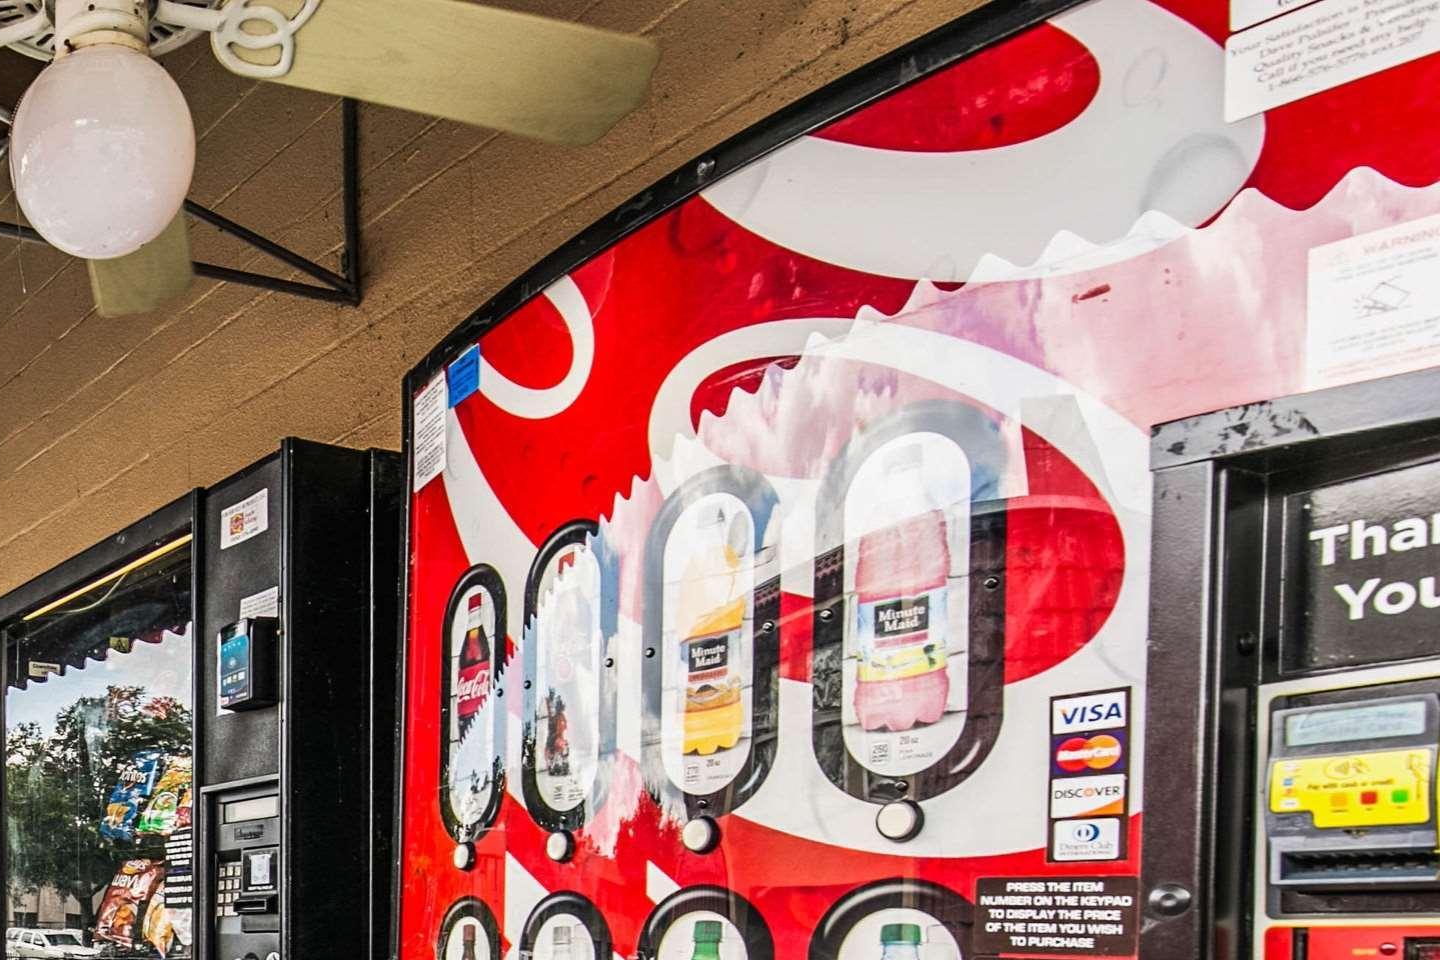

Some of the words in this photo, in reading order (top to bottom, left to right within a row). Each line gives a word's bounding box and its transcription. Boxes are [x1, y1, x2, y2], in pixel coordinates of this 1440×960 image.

[1308, 511, 1440, 566] Tha
[878, 604, 926, 622] Minute
[884, 618, 921, 633] Maid
[691, 643, 726, 659] Minute
[695, 655, 722, 668] Maid
[1061, 702, 1122, 725] VISA
[1054, 785, 1121, 800] DISCOVER
[1006, 882, 1045, 893] PRESS
[1047, 882, 1071, 893] THE
[1072, 882, 1104, 893] ITEM
[980, 896, 1032, 906] NUMBER
[1033, 896, 1053, 906] ON
[1055, 896, 1079, 907] THE
[1080, 896, 1132, 907] KEYPAD
[988, 909, 1005, 919] TO
[1006, 909, 1056, 920] DISPLAY
[1058, 910, 1082, 920] THE
[1084, 910, 1121, 921] PRICE
[985, 922, 1001, 933] OF
[1004, 922, 1026, 933] THE
[1027, 923, 1057, 934] ITEM
[1059, 923, 1085, 935] YOU
[1087, 924, 1123, 935] WISH
[1009, 936, 1026, 947] TO
[1028, 937, 1095, 948] PURCHASE
